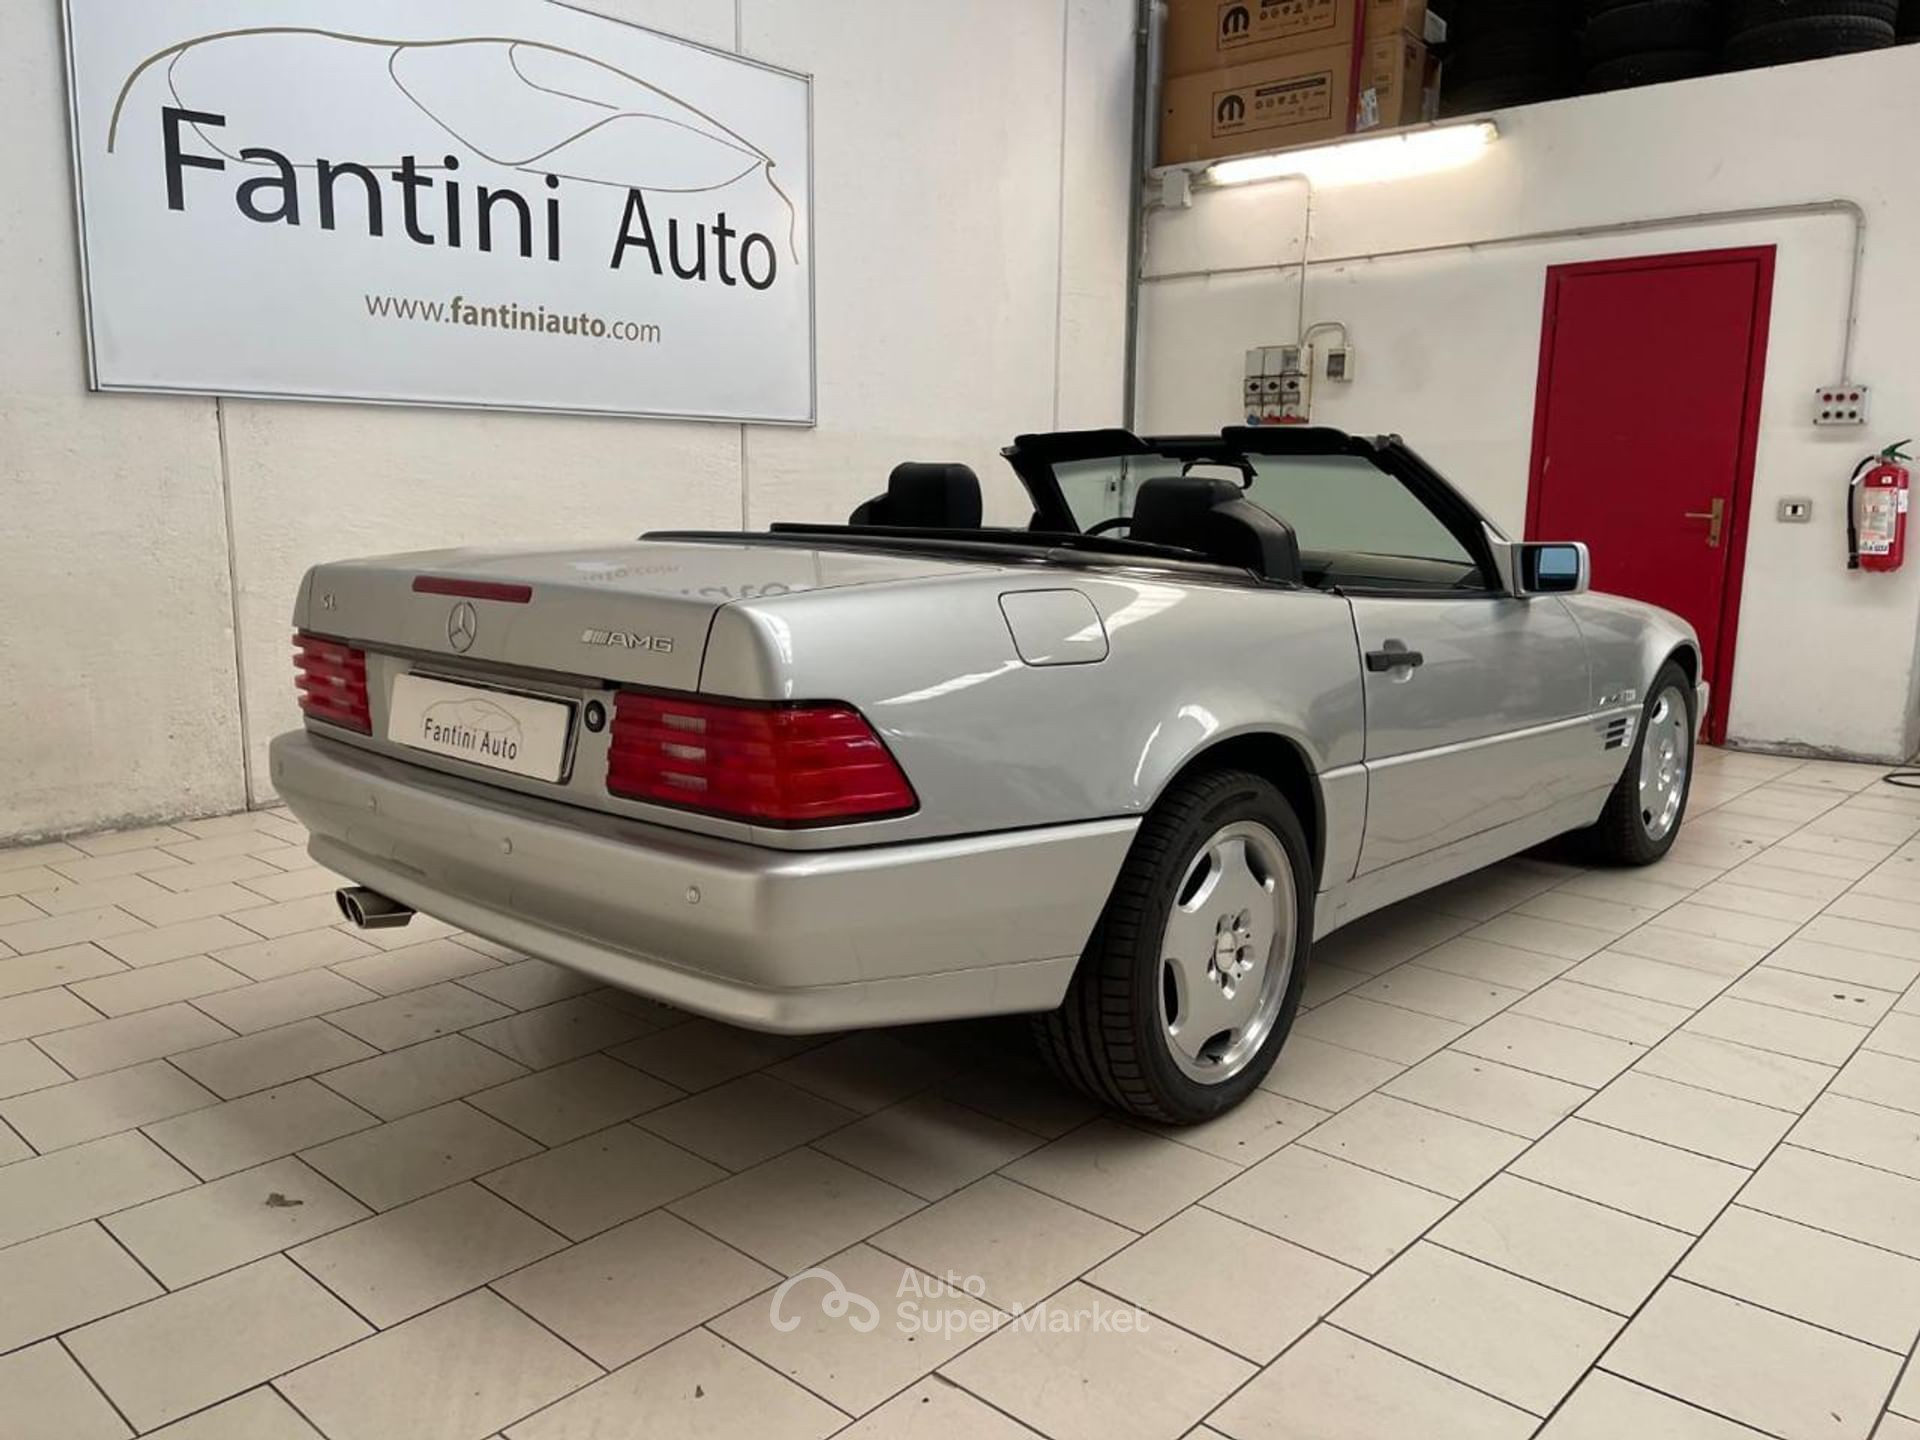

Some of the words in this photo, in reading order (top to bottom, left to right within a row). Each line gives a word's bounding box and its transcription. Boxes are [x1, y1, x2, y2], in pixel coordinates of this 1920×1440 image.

[162, 106, 560, 261] Fantini
[610, 188, 777, 291] Auto
[365, 294, 661, 343] www.fantiniauto.com
[322, 591, 336, 611] SL
[606, 631, 674, 654] AMG
[424, 717, 477, 750] Fantini
[480, 731, 518, 760] Auto
